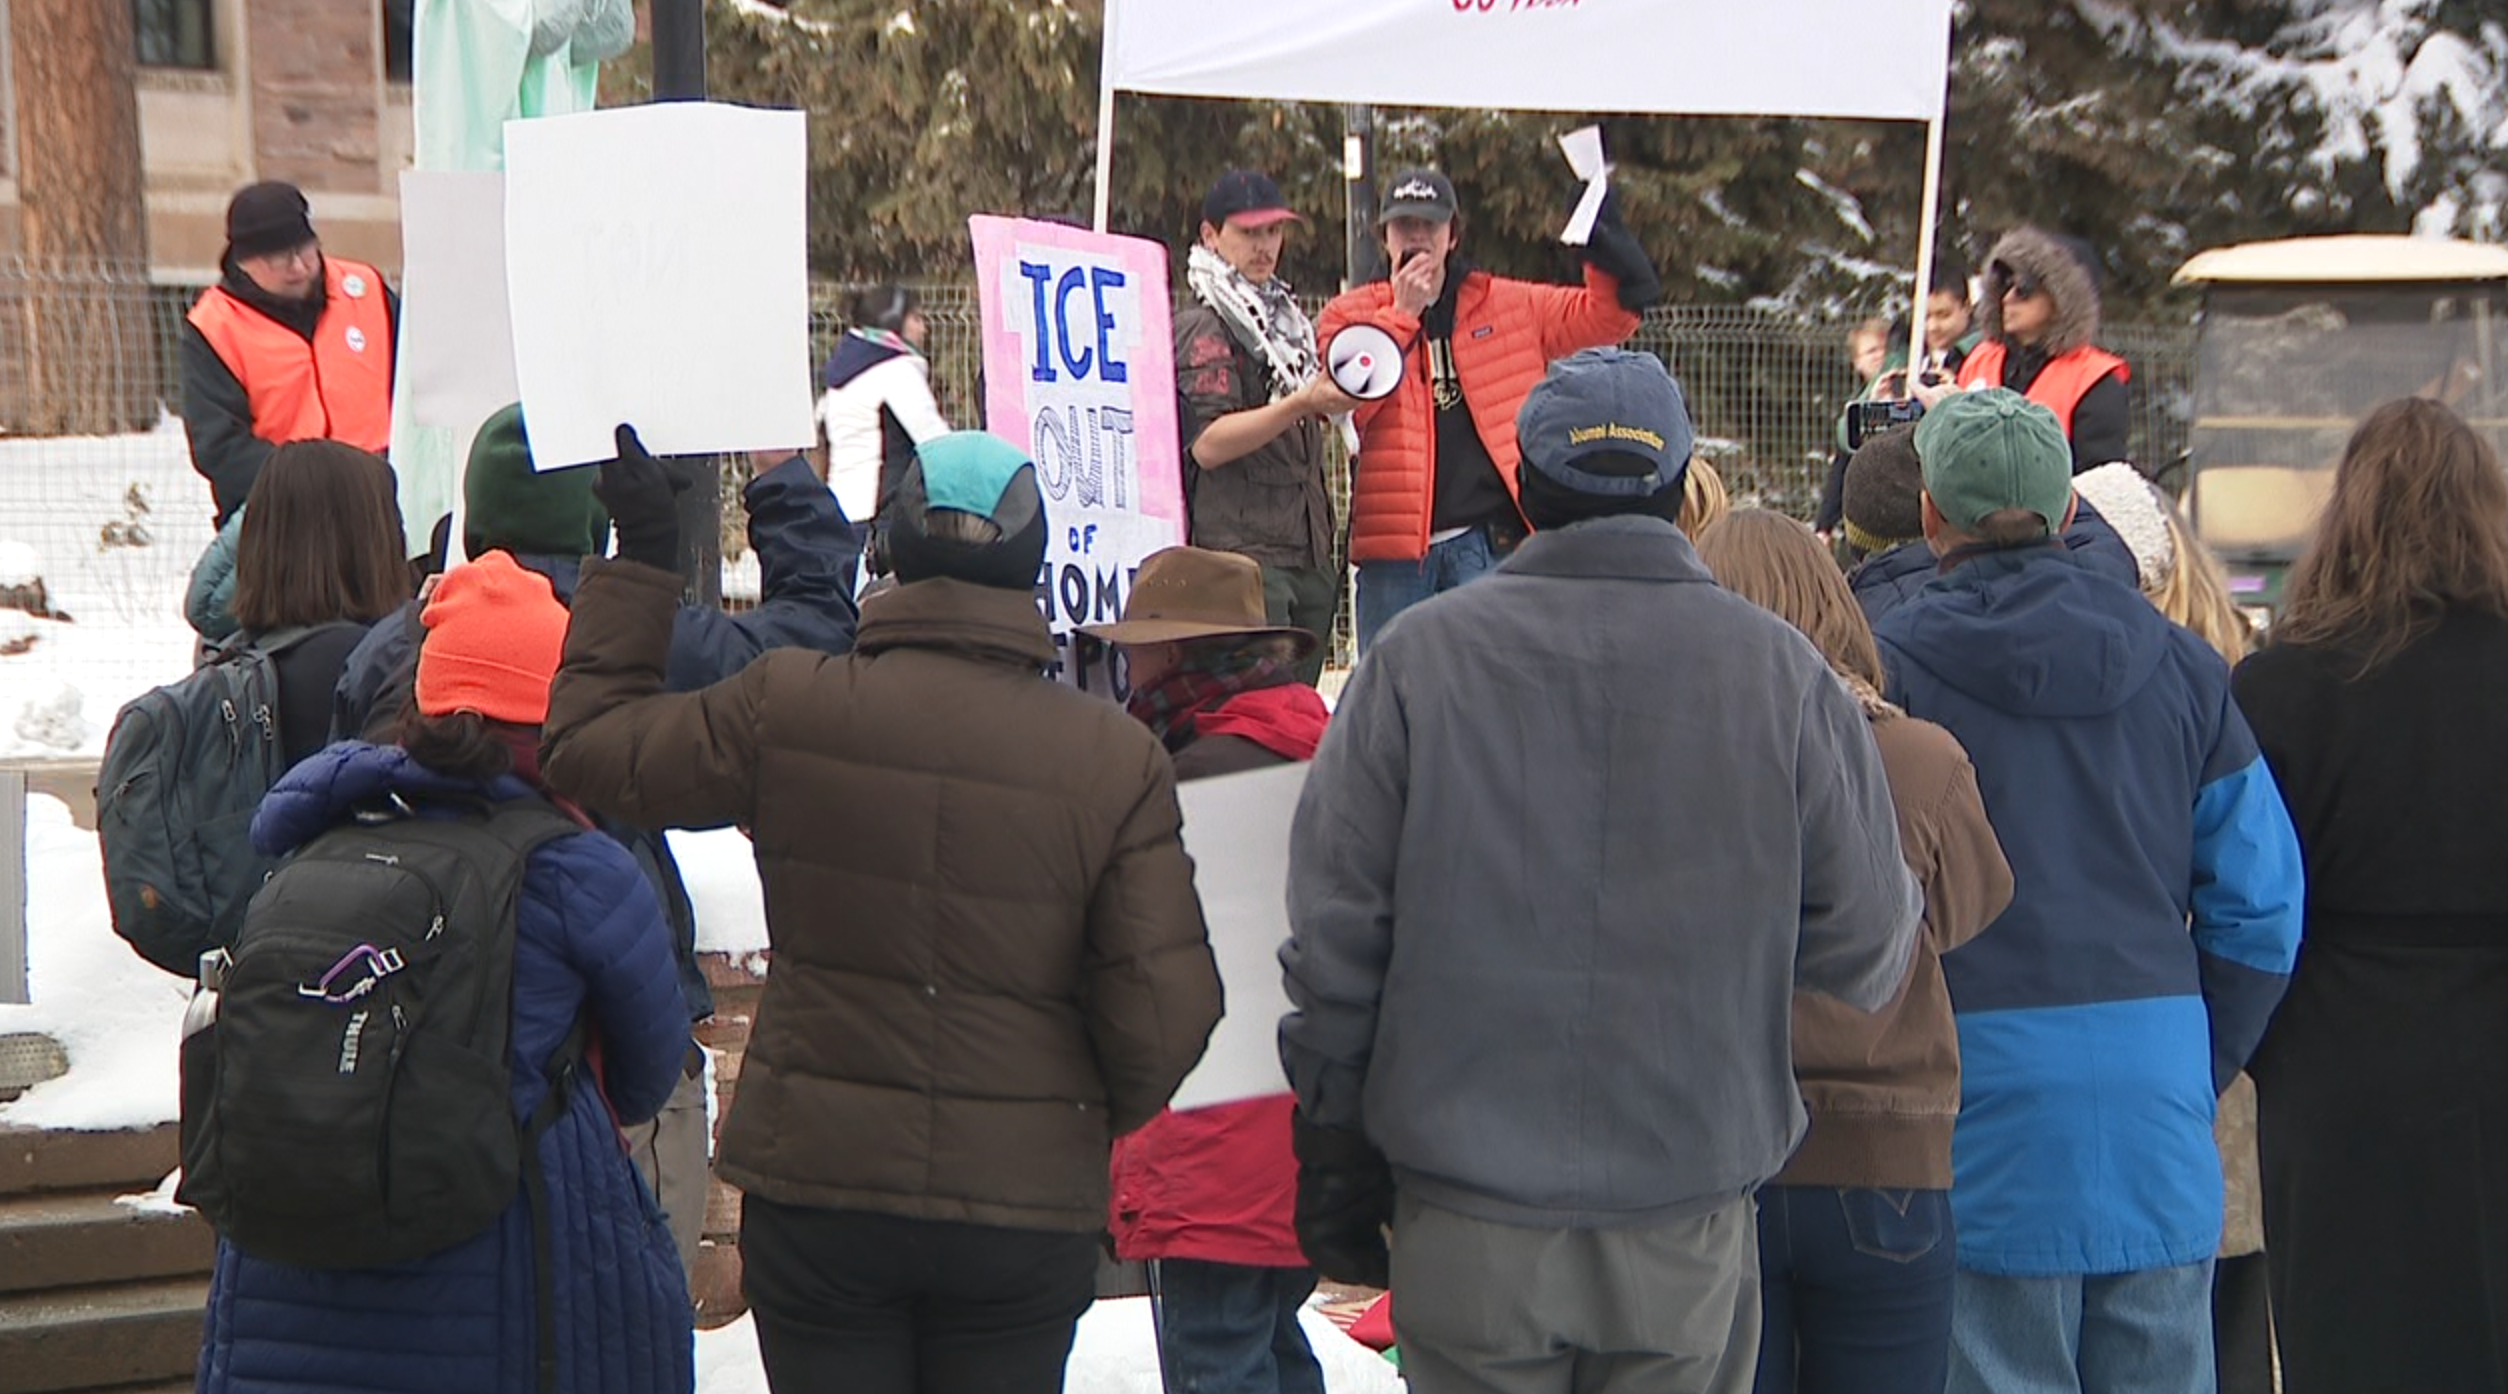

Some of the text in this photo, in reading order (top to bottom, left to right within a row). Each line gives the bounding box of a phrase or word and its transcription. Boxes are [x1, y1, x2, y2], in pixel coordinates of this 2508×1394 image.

[1020, 260, 1128, 384] ICE
[1034, 404, 1134, 509] OUT
[1569, 421, 1665, 451] Alumni Association
[1068, 524, 1097, 554] OF
[1033, 561, 1138, 626] HOM
[339, 1010, 369, 1073] THULE
